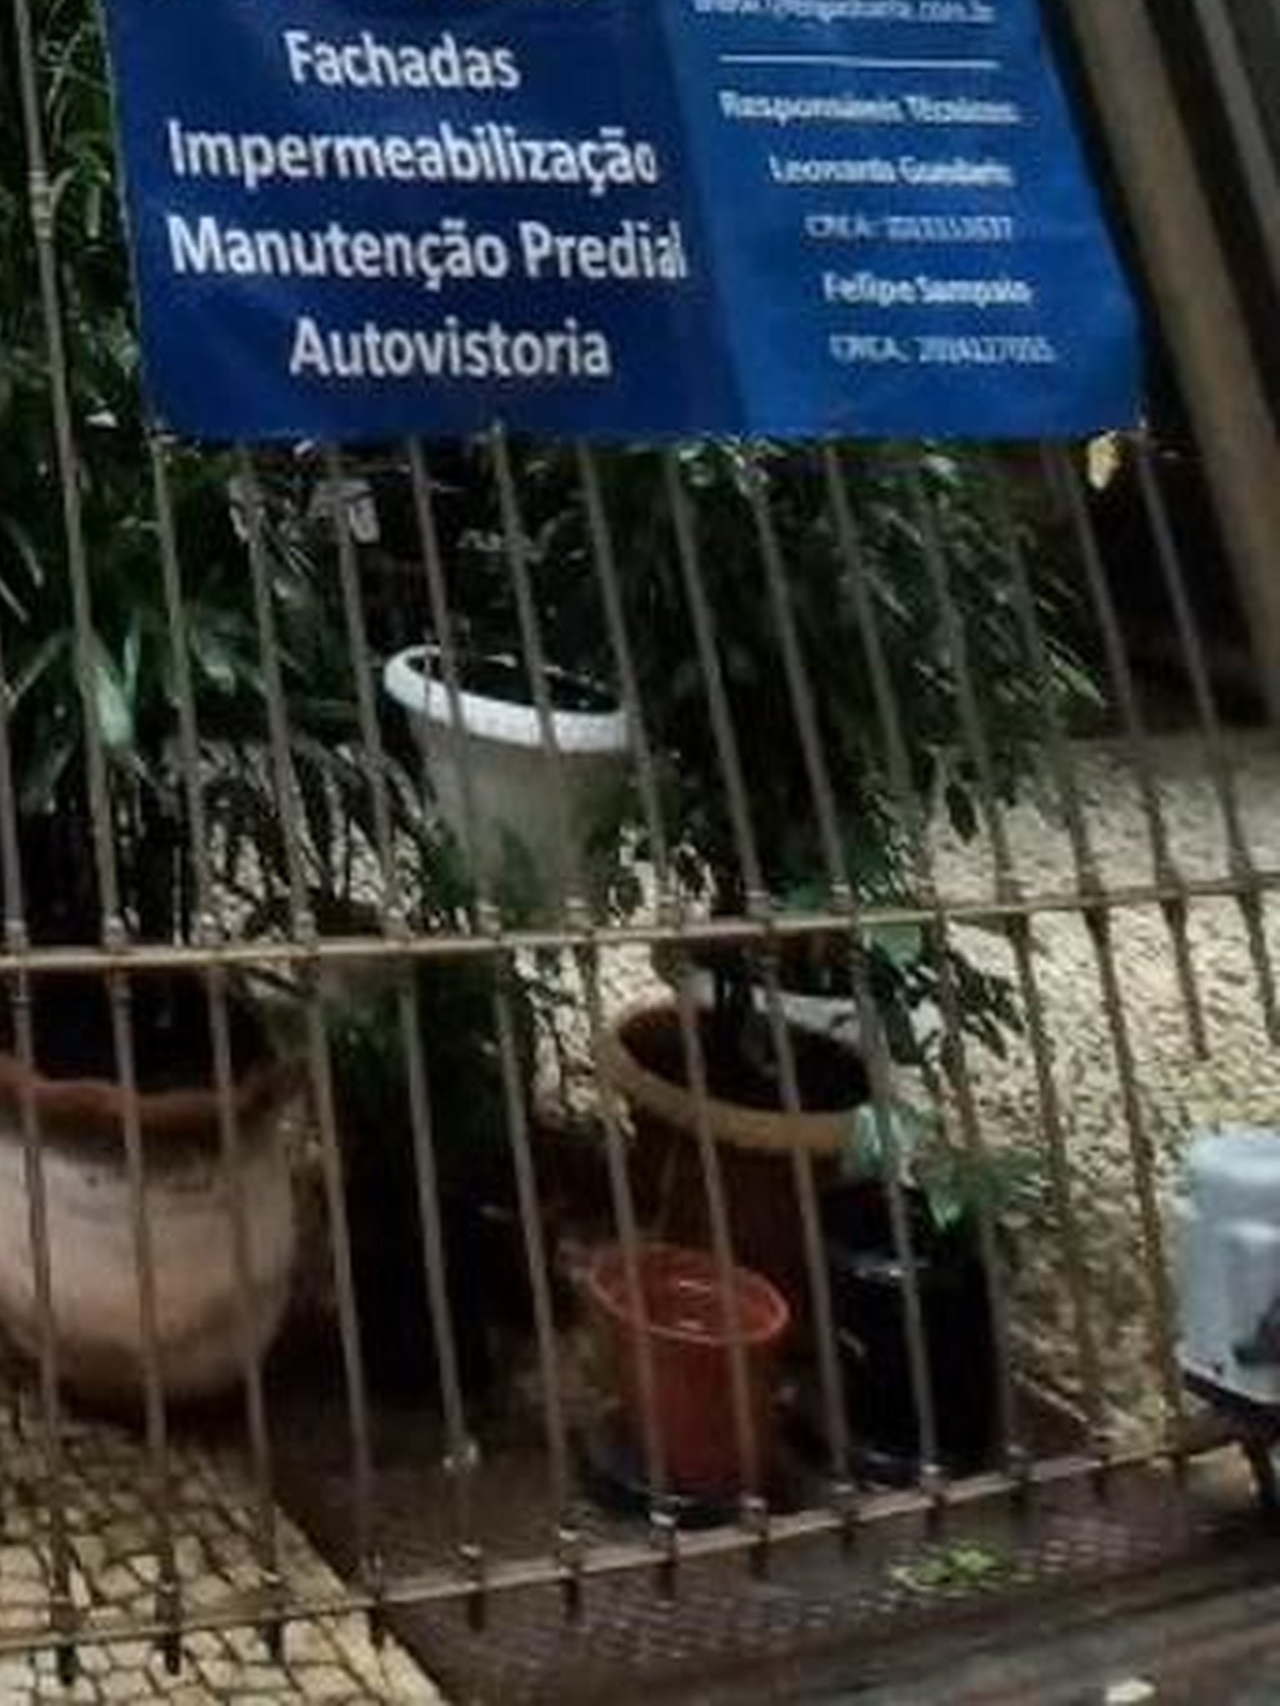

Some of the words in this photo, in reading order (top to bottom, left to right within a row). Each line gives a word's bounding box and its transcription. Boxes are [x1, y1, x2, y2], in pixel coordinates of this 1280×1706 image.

[284, 30, 521, 89] Fachadas
[167, 117, 659, 197] Impermeabilização
[166, 214, 508, 290] Manutenção
[518, 219, 689, 281] Predial
[289, 315, 613, 379] Autovistoria
